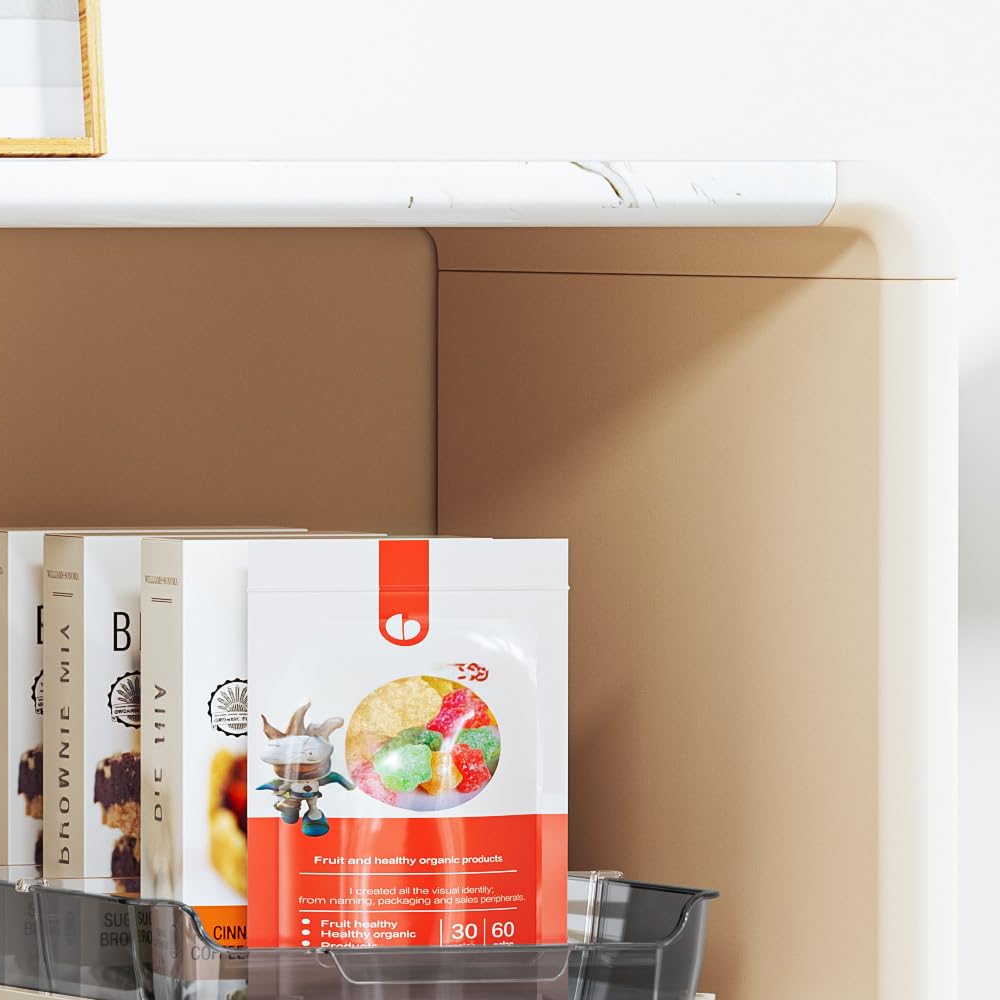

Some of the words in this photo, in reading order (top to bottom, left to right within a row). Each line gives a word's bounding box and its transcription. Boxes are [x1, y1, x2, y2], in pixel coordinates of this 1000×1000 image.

[313, 856, 345, 865] Fruit
[347, 856, 372, 865] and
[374, 856, 416, 866] healthy
[419, 855, 460, 866] organic
[462, 854, 504, 865] products
[355, 887, 397, 895] created
[398, 887, 410, 895] all
[412, 887, 429, 895] the
[431, 886, 460, 895] visual
[298, 895, 326, 904] from
[377, 896, 431, 906] packaging
[433, 896, 453, 904] and
[454, 895, 479, 904] sales
[320, 919, 351, 928] Fruit
[354, 919, 398, 929] healthy
[491, 921, 515, 938] 60
[213, 925, 247, 940] CINN
[320, 929, 370, 940] Healthy
[373, 929, 417, 940] organic
[451, 923, 478, 939] 30
